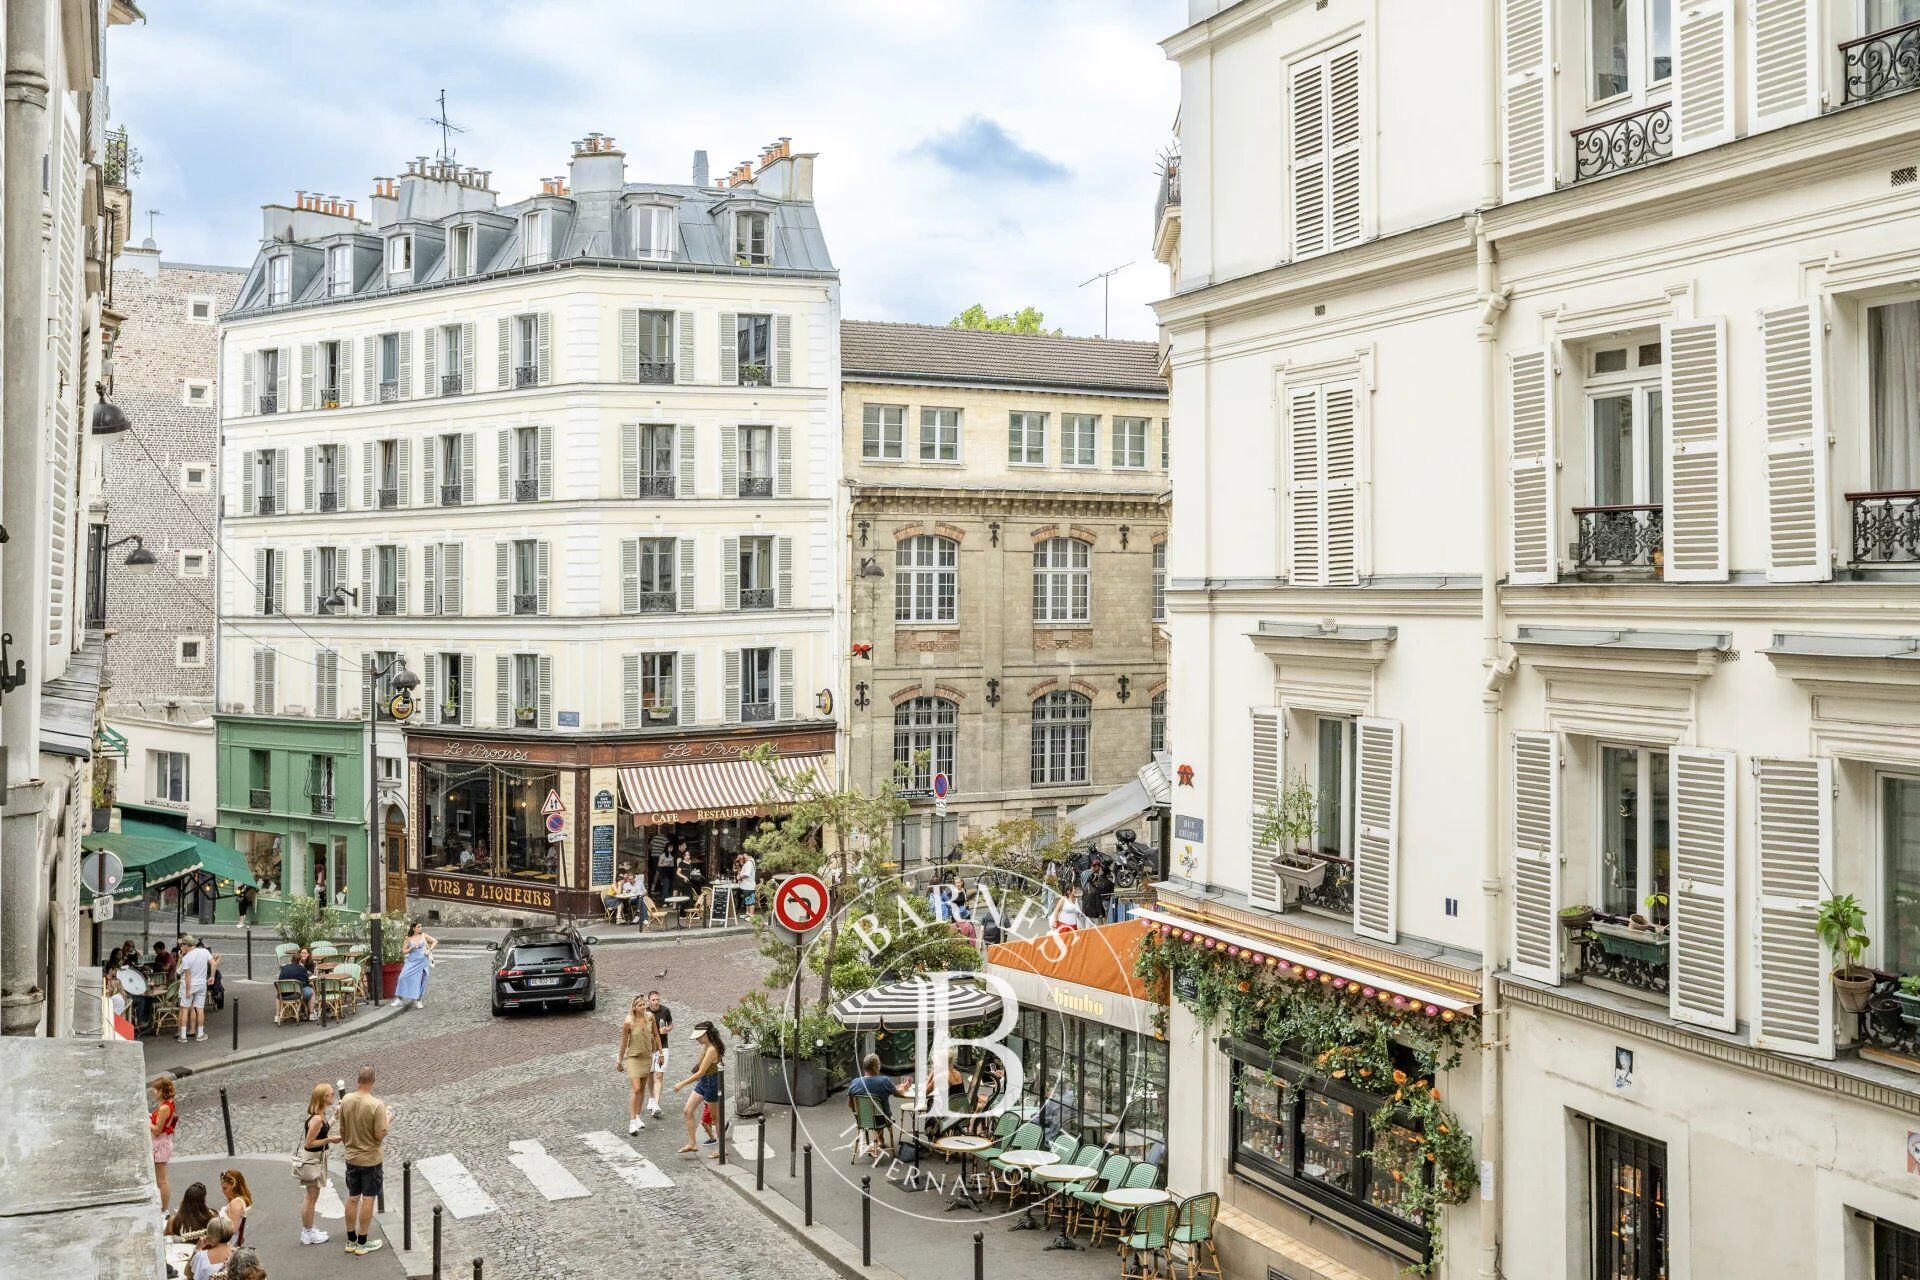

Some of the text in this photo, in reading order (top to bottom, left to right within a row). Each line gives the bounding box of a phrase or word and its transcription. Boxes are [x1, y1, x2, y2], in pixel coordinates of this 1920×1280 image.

[443, 742, 529, 761] Le Progrès
[663, 741, 779, 759] Le Progs
[651, 806, 758, 824] CAFE RESTAURANT
[428, 878, 551, 907] VINS & LIQUEURS
[1055, 986, 1104, 1016] bimbo
